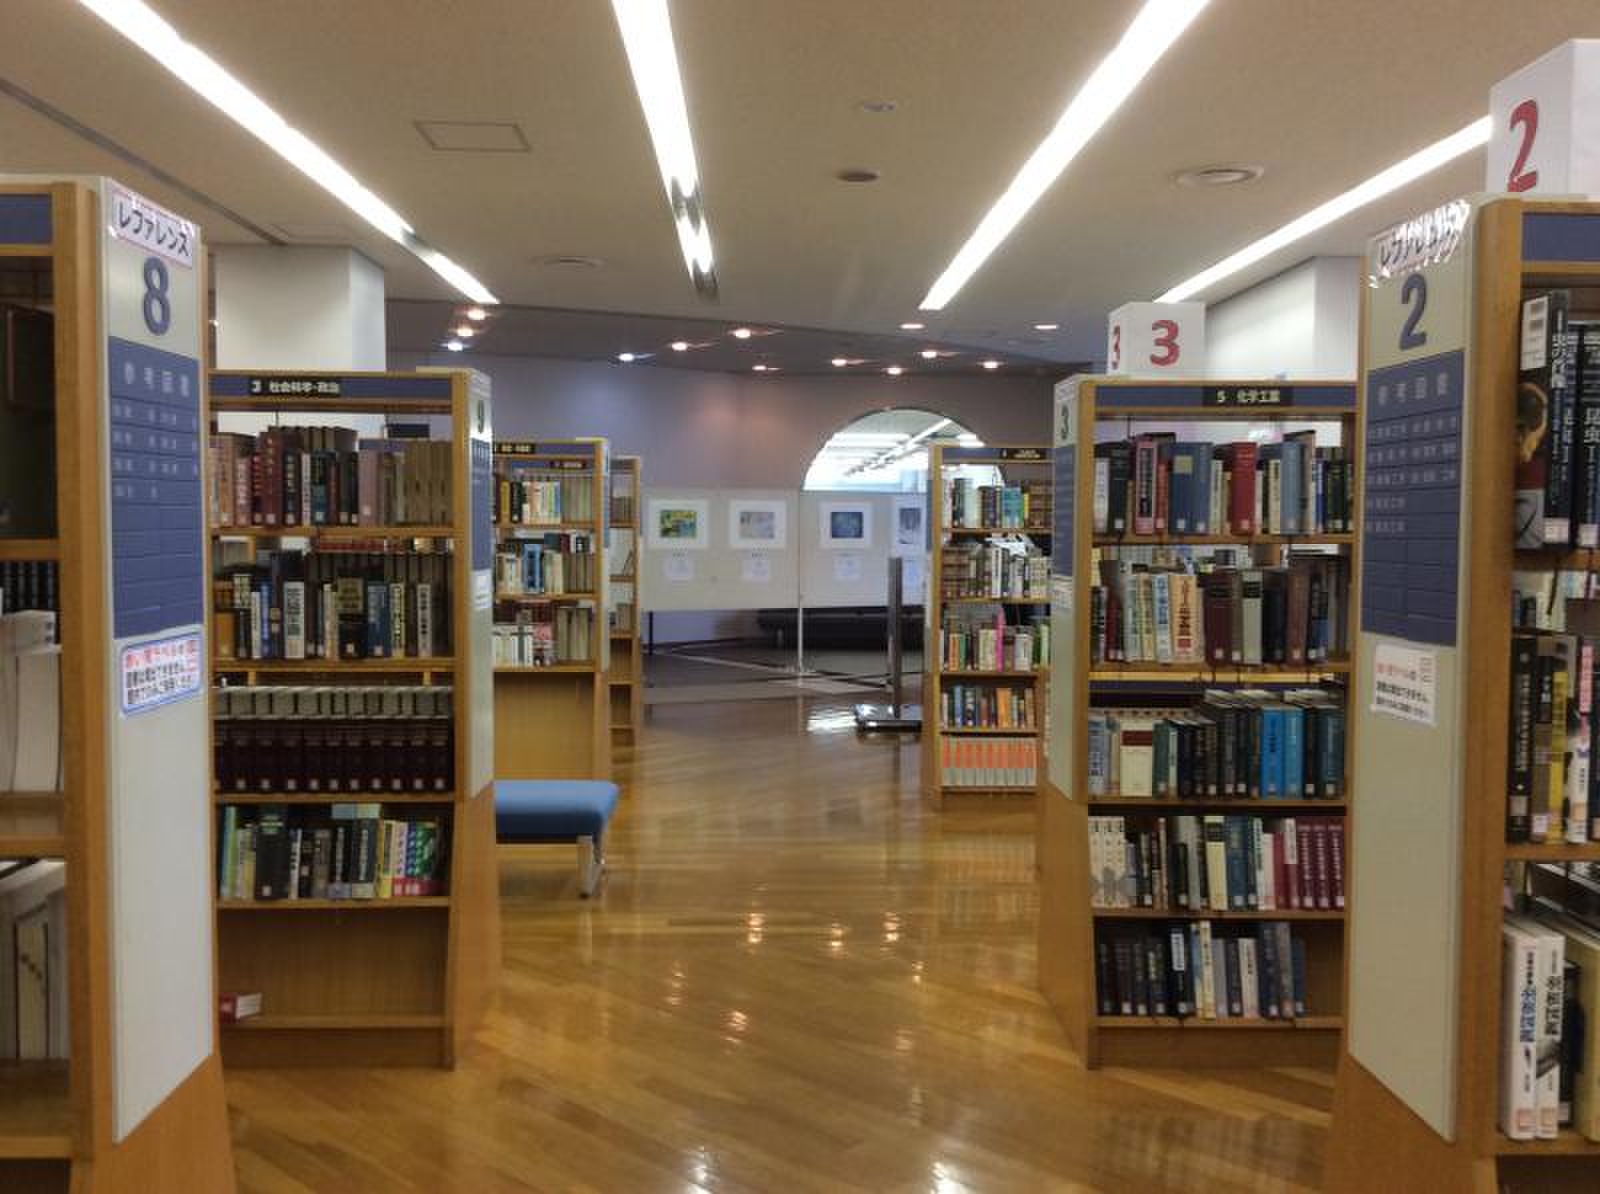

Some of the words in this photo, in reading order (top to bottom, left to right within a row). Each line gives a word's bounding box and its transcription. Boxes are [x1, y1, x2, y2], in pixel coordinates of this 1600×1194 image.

[1507, 99, 1539, 193] 2
[118, 201, 189, 257] レファレンス
[143, 256, 171, 335] 8
[1400, 273, 1427, 351] 2
[1151, 319, 1180, 367] 3
[1061, 405, 1069, 440] 3
